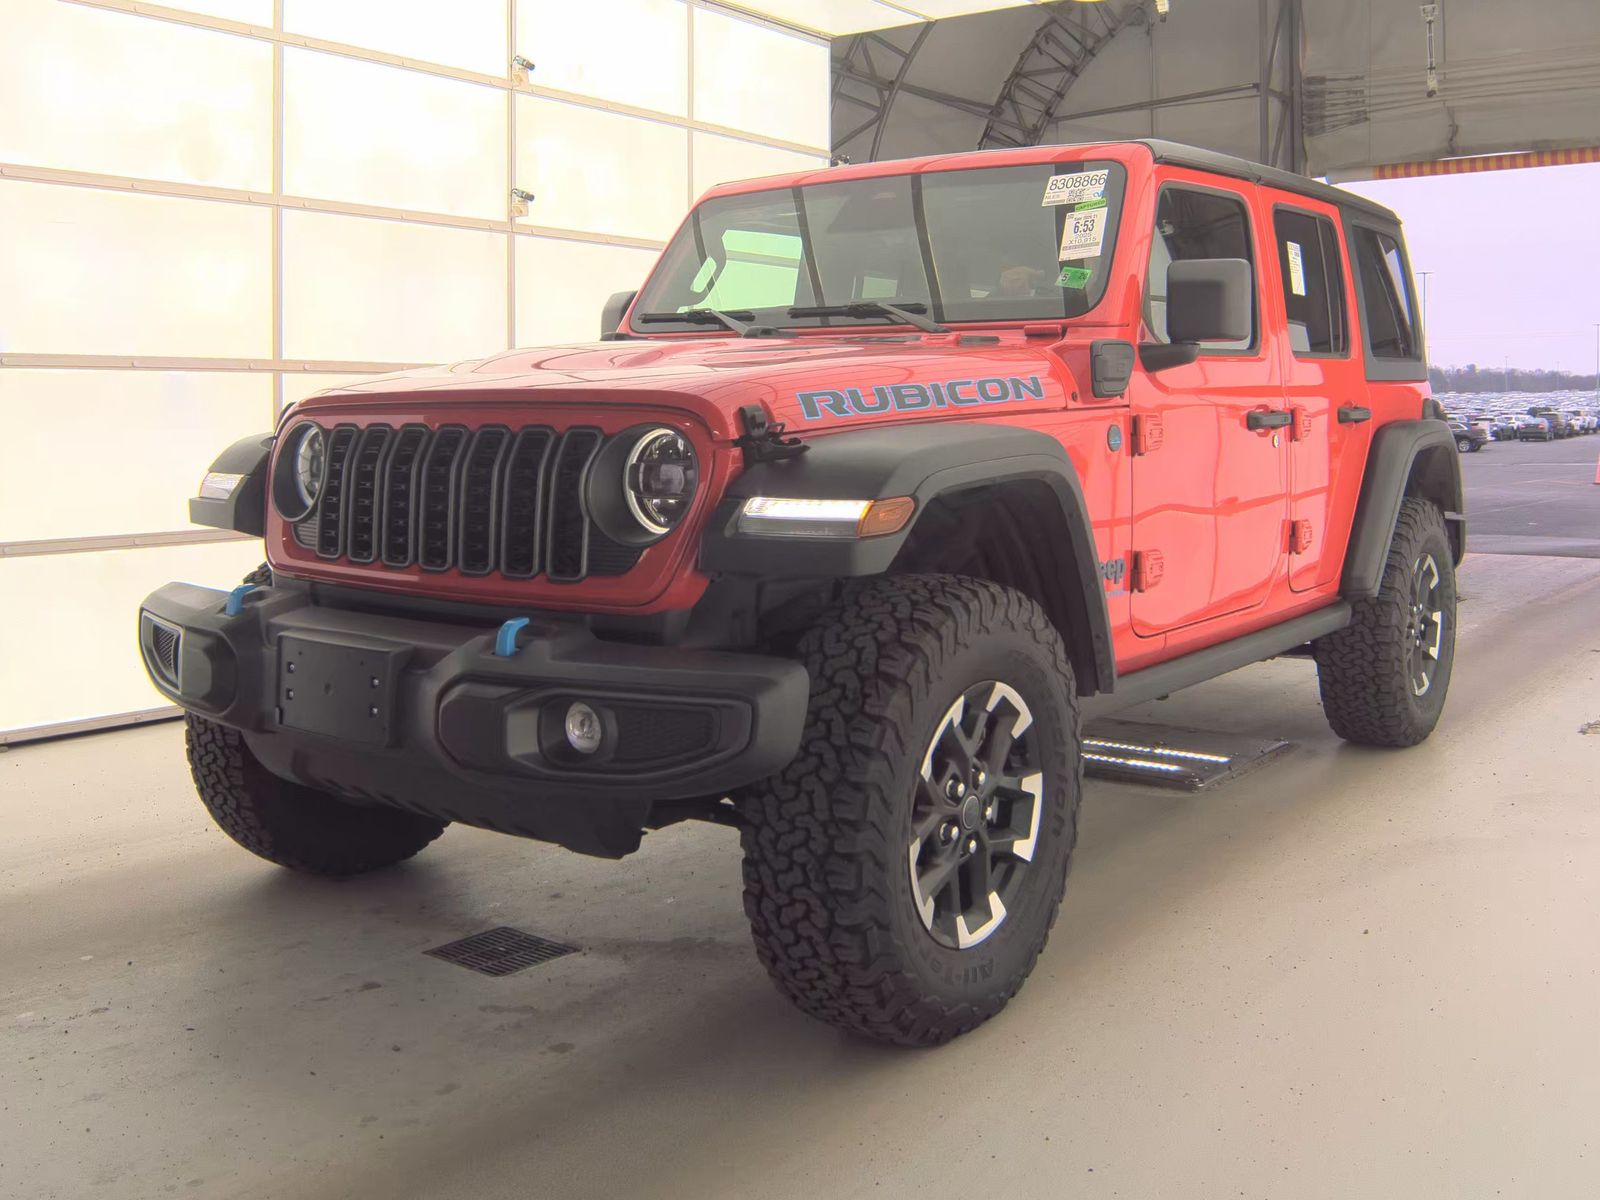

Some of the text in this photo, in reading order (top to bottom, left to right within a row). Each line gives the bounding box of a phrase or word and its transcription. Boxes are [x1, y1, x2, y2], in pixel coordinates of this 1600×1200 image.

[1050, 174, 1107, 191] 8308866
[1075, 199, 1106, 211] CAPTURED
[1073, 219, 1095, 234] 6:53
[797, 376, 1044, 419] RUBICON
[1098, 558, 1126, 585] eep
